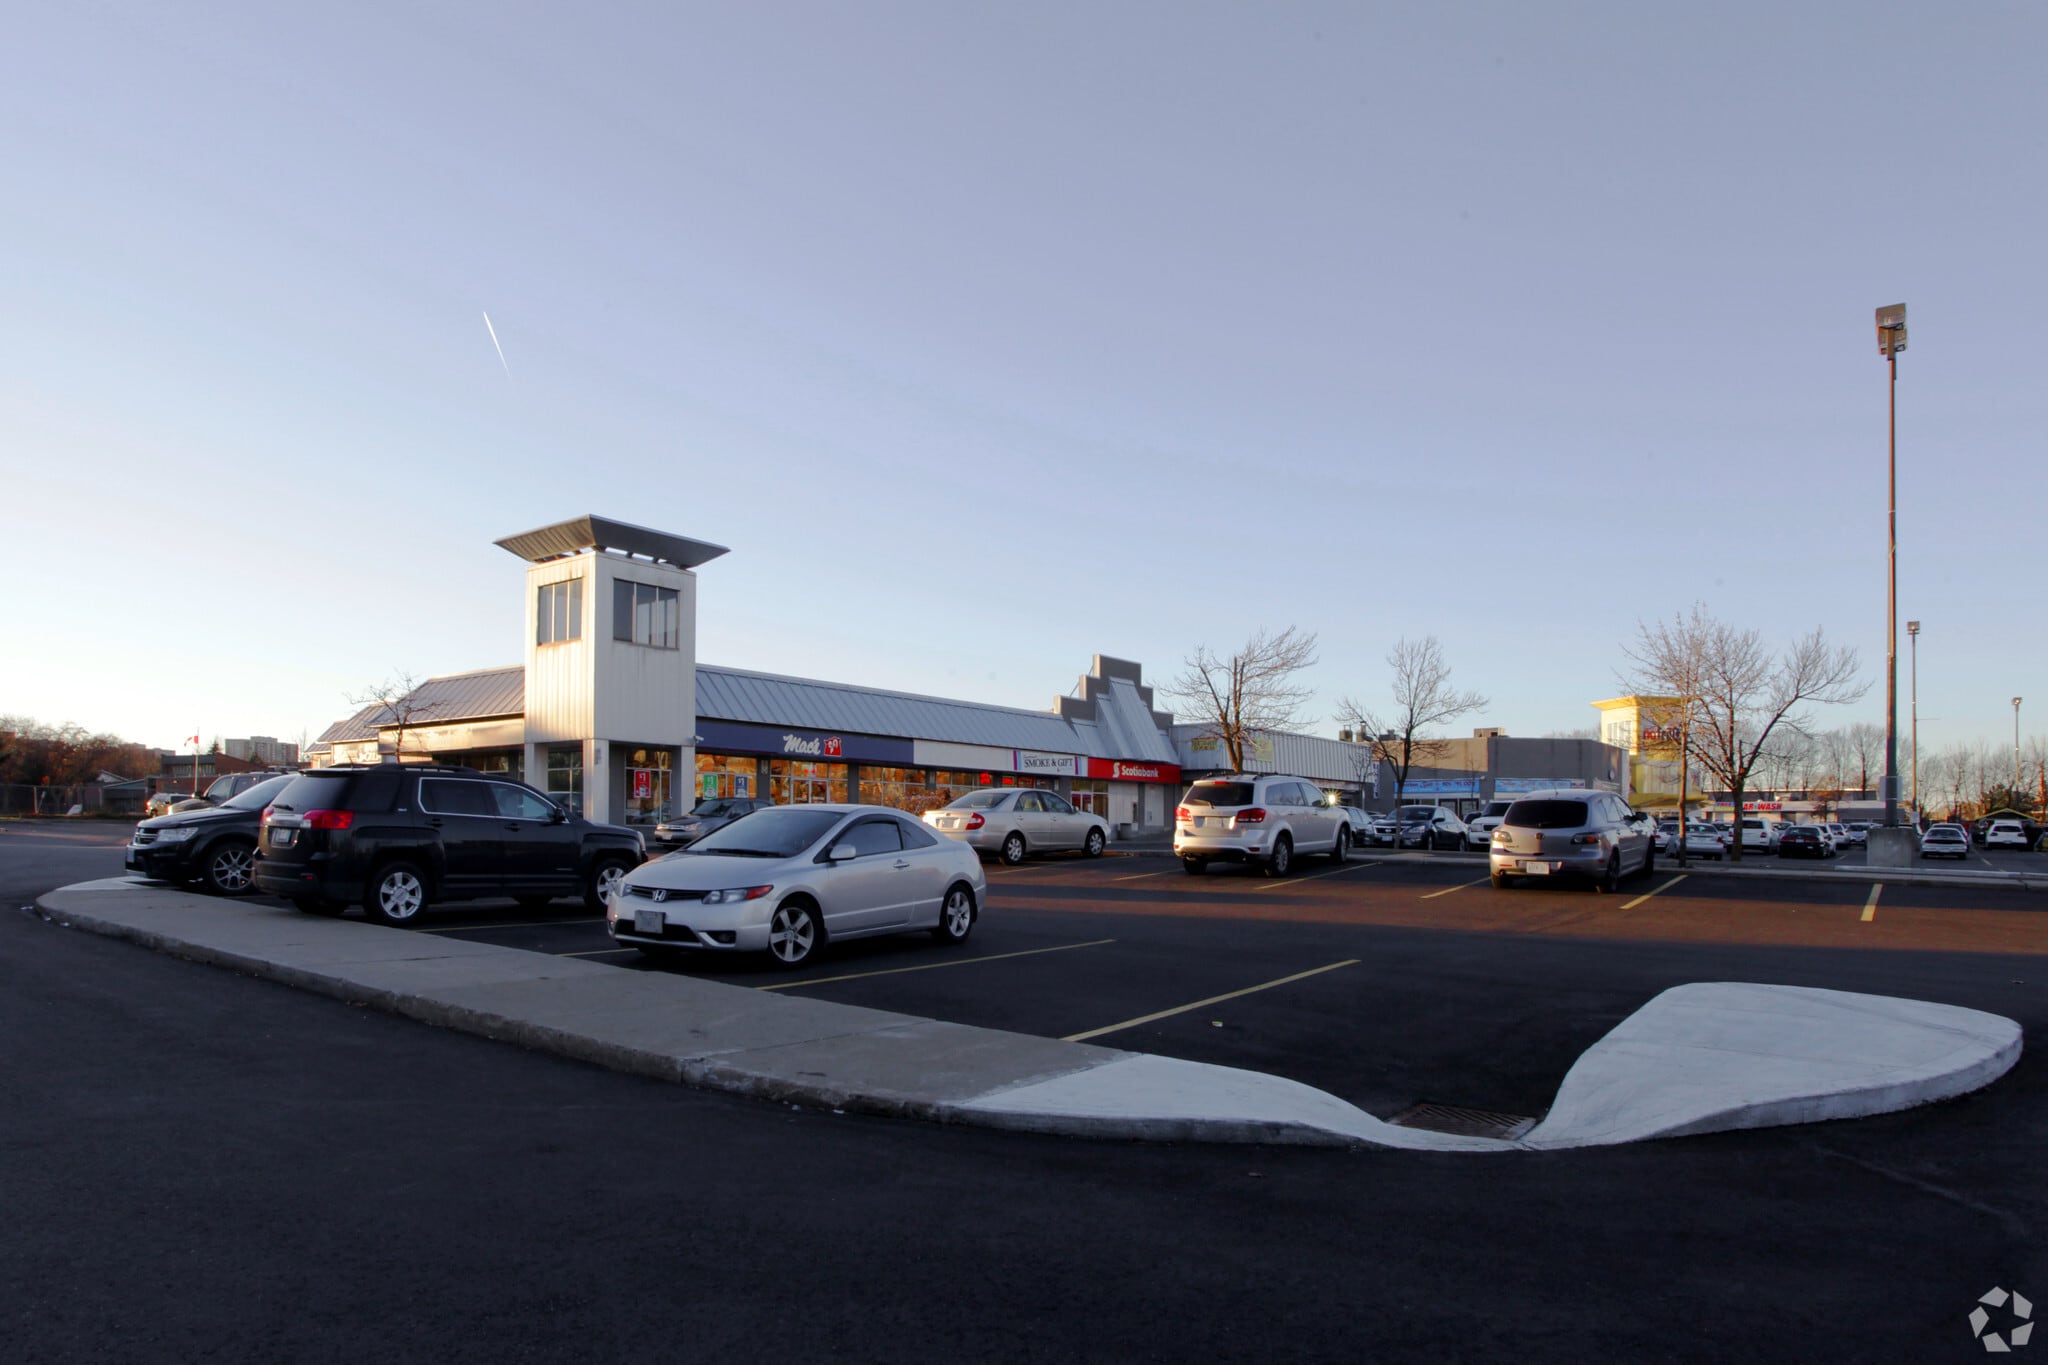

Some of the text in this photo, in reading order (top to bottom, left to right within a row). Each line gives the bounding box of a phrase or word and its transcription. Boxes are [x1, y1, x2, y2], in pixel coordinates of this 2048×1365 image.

[783, 734, 820, 755] Mac's
[1024, 758, 1073, 768] SMOKE & GIFT
[1121, 765, 1159, 778] Scotiabank
